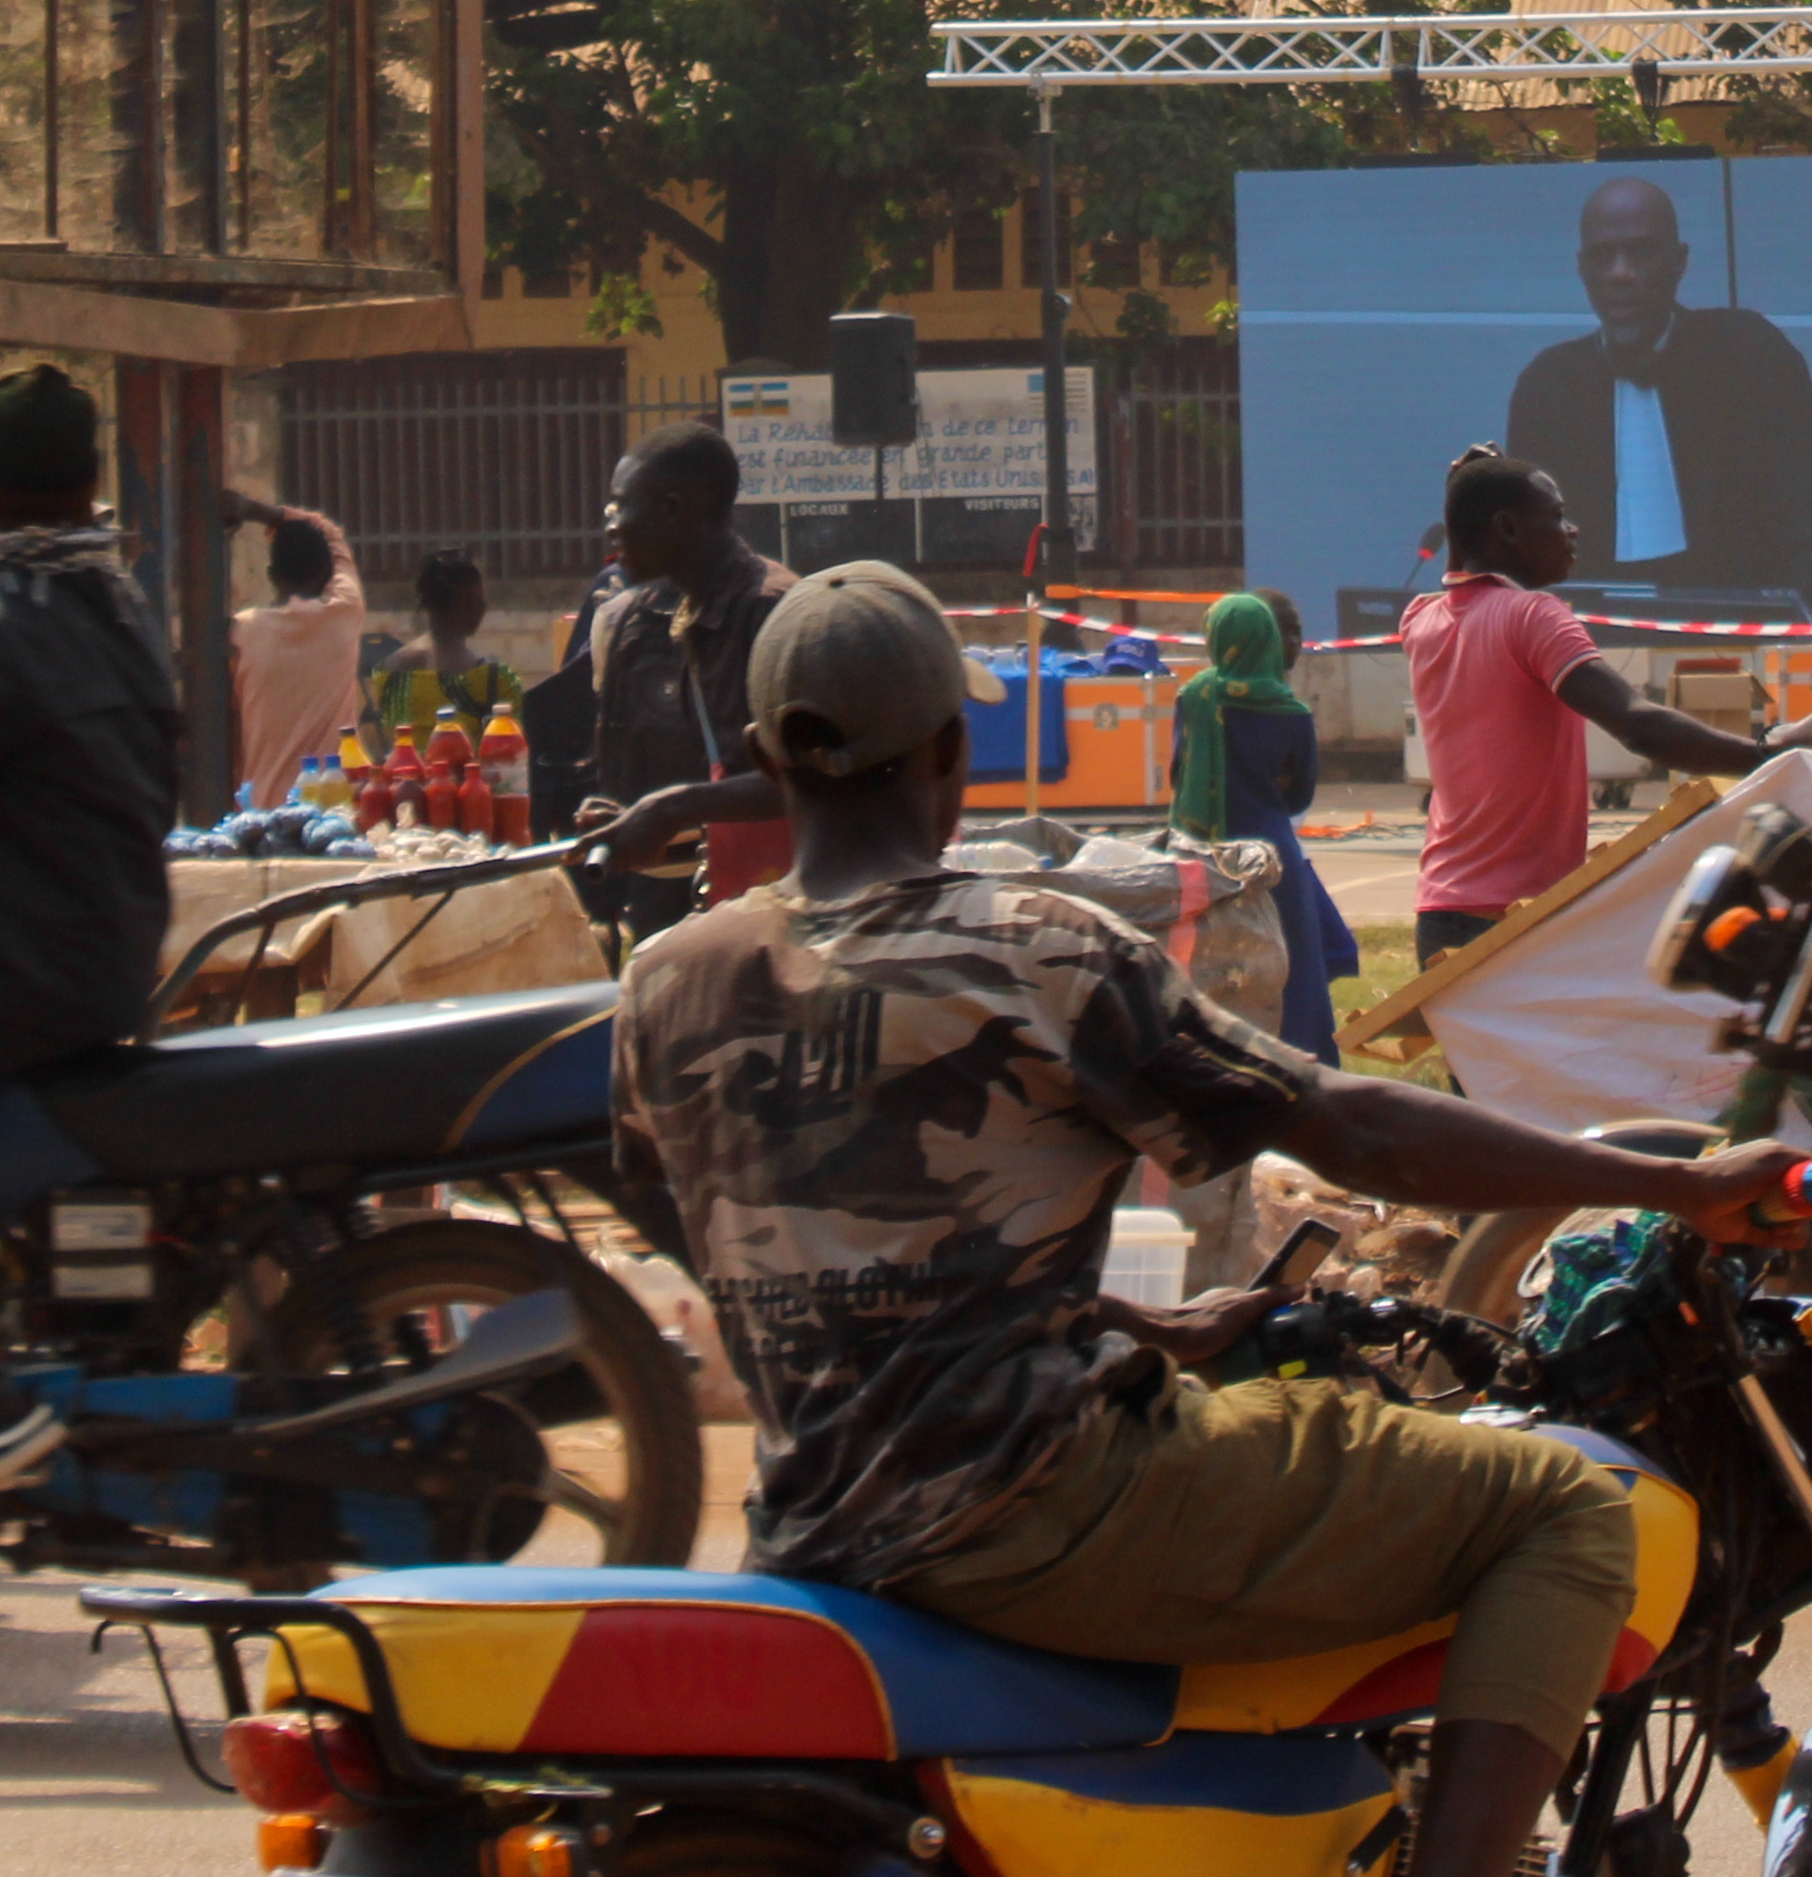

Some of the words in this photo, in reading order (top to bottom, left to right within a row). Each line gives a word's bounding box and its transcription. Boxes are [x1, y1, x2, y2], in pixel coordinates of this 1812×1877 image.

[739, 423, 760, 443] La
[942, 417, 970, 436] de
[974, 418, 996, 436] ce
[917, 443, 993, 468] grande
[789, 503, 849, 518] LOCAUX
[964, 497, 1040, 512] VISITEURS
